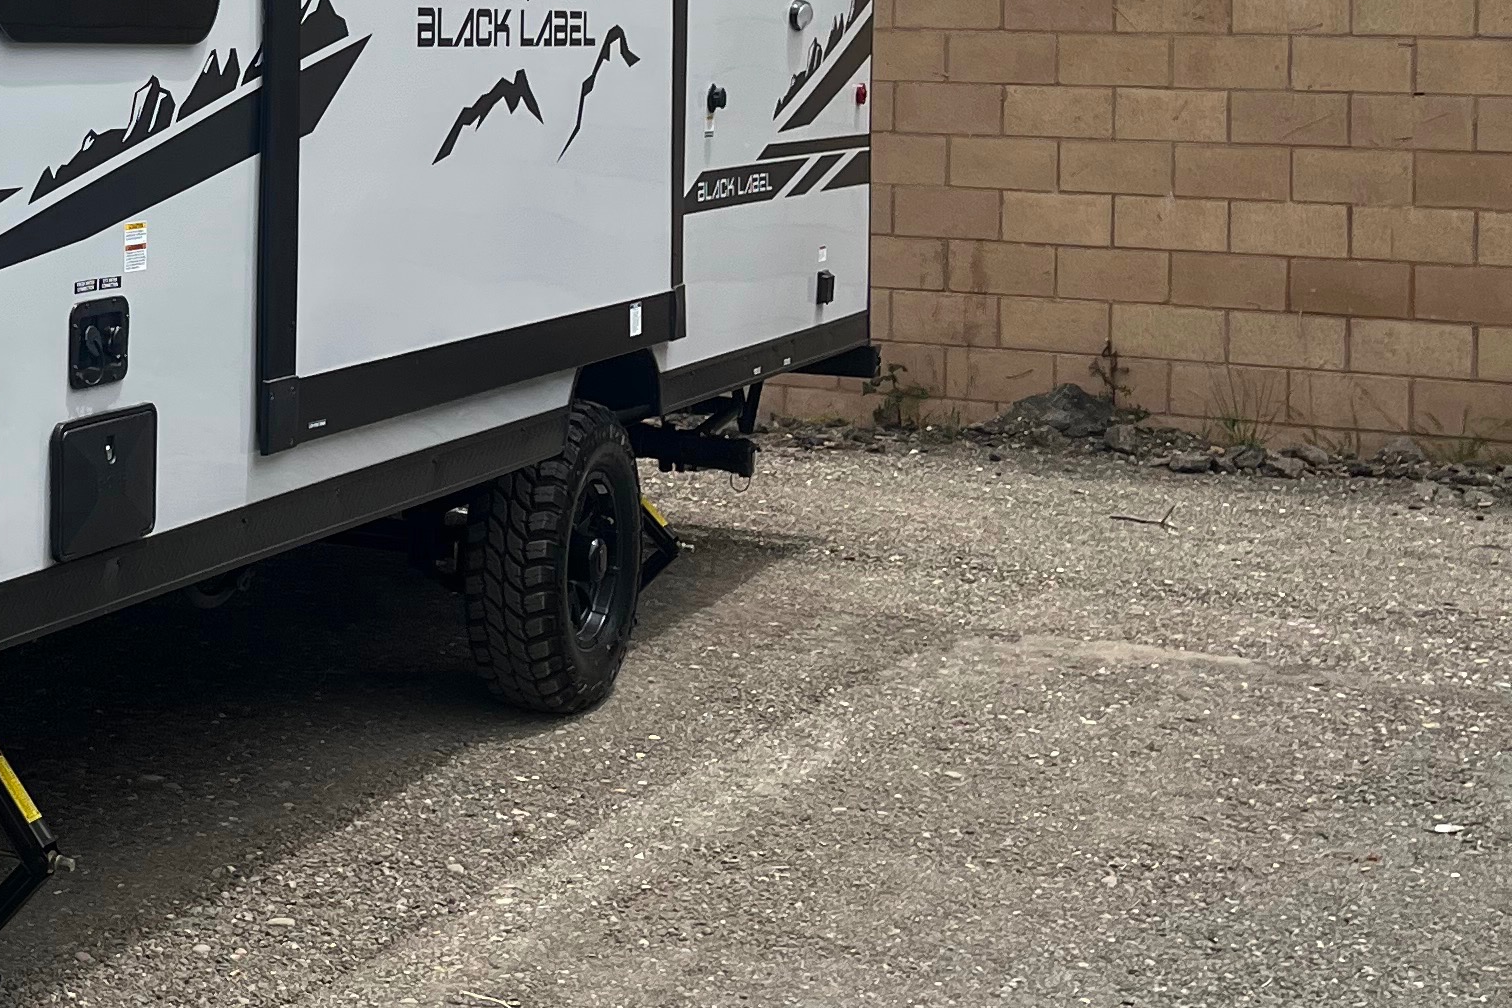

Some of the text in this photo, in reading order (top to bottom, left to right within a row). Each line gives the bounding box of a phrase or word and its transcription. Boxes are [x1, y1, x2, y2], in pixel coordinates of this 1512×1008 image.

[416, 7, 596, 48] BLACK LABEL
[697, 172, 773, 203] BLACK LABEL
